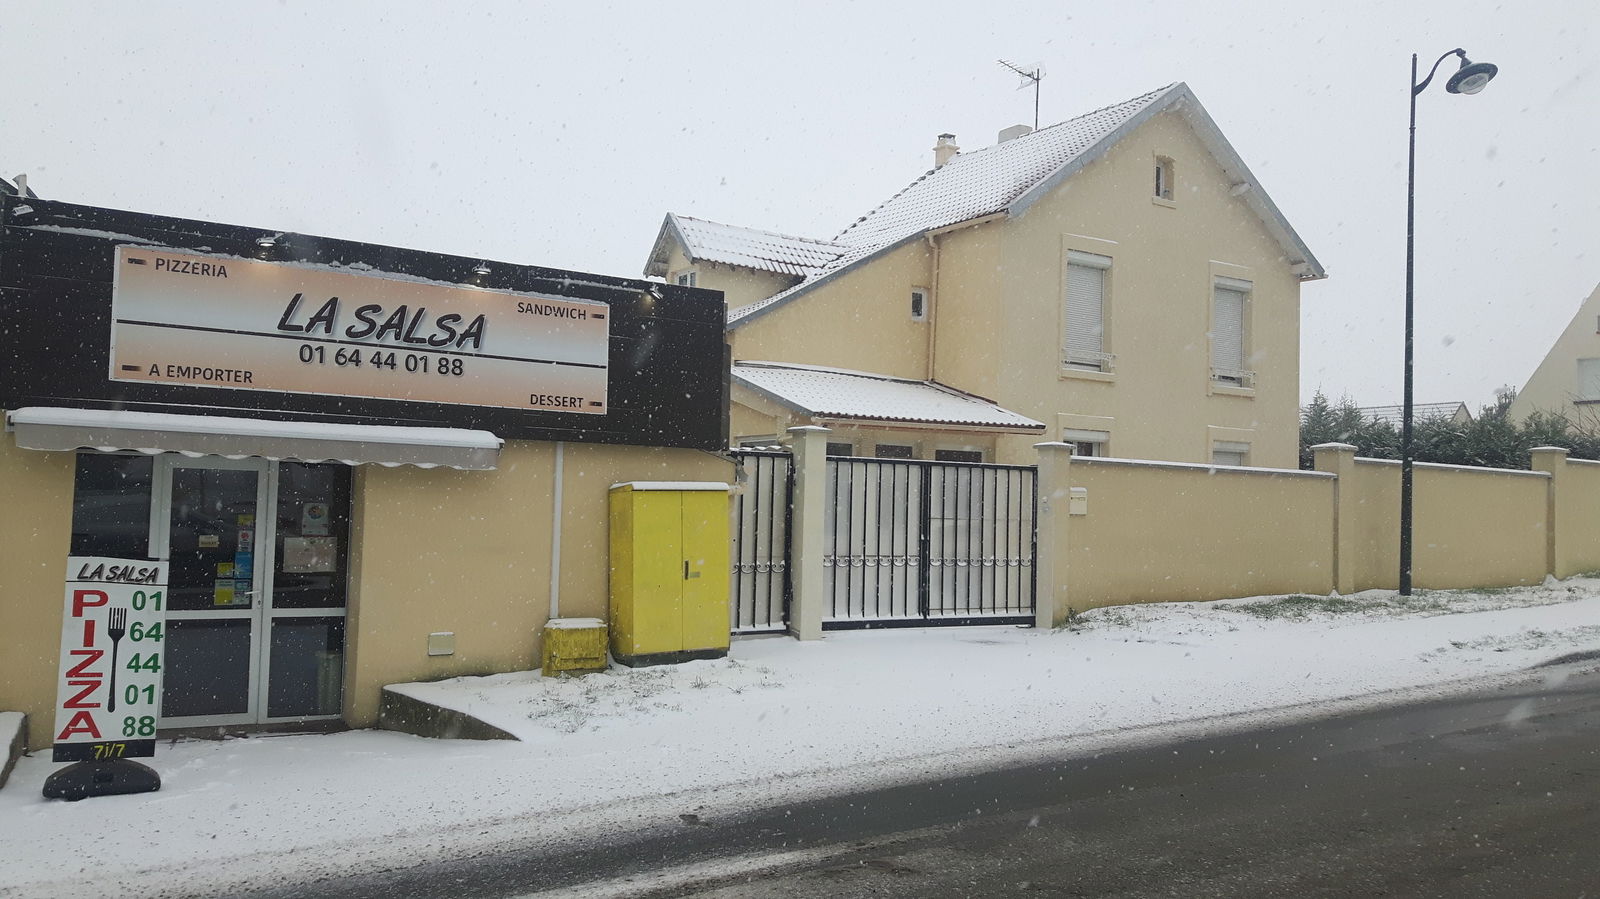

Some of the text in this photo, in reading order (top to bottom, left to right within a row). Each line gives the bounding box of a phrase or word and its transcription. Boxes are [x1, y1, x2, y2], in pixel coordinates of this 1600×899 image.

[155, 257, 228, 279] PIZZERIA
[276, 293, 486, 350] LA SALSA
[517, 301, 587, 321] SANDWICH
[300, 344, 464, 377] 01 64 44 01 88
[149, 363, 253, 384] A EMPORTER
[530, 393, 584, 409] DESSERT
[77, 563, 159, 584] LA SALSA
[132, 590, 163, 611] 01
[129, 621, 164, 643] 64
[126, 652, 161, 673] 44
[124, 684, 155, 705] 01
[122, 715, 156, 737] 88
